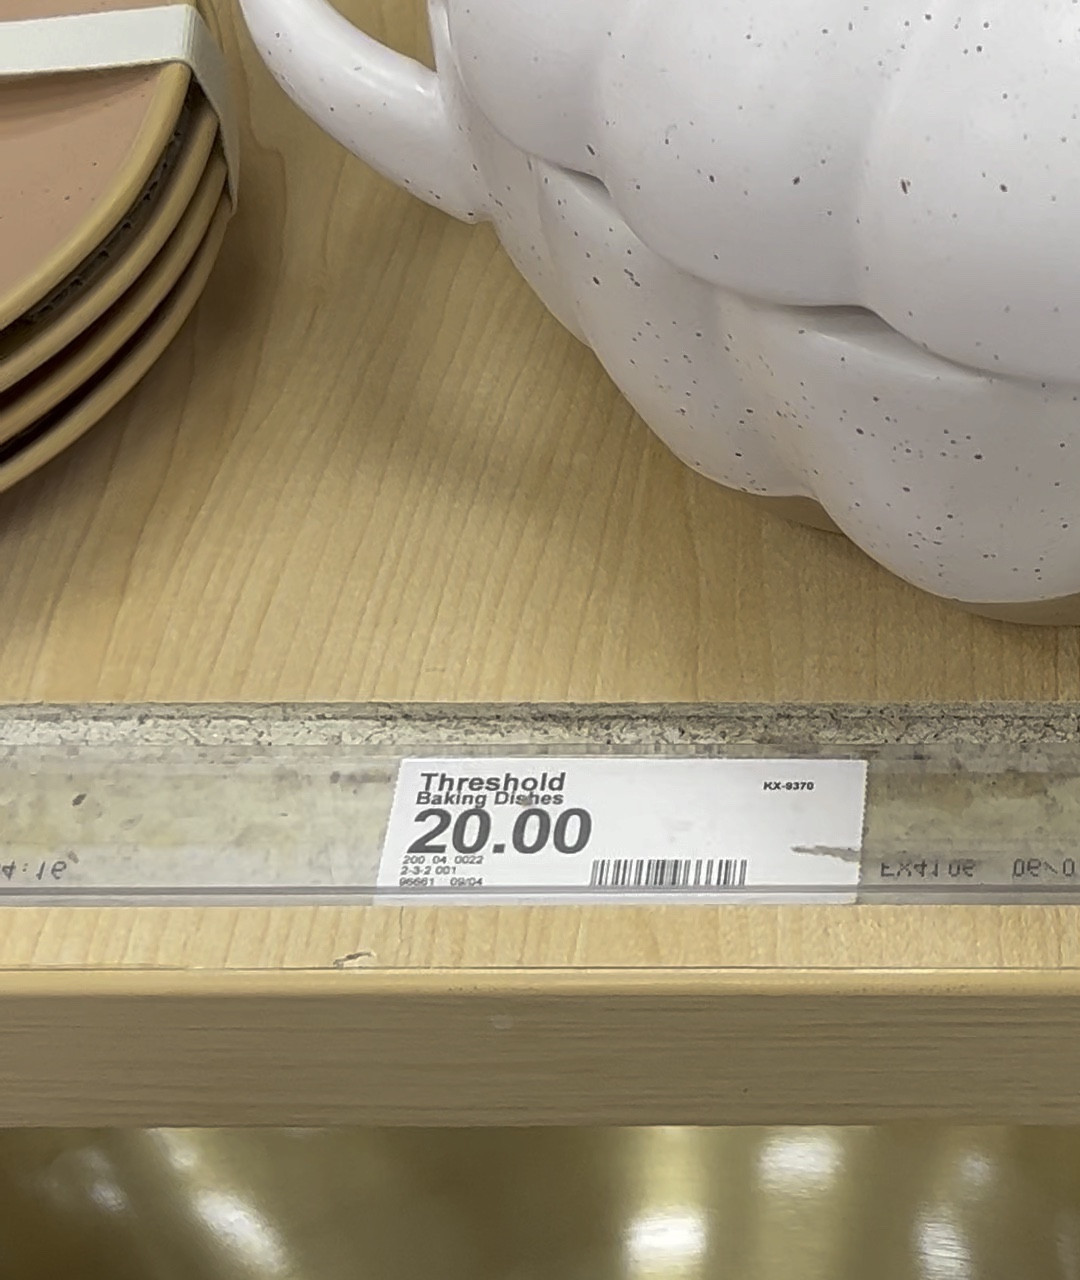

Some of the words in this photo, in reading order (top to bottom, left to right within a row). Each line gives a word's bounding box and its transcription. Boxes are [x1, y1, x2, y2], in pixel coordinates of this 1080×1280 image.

[420, 771, 567, 792] Threshold
[416, 791, 487, 809] Baking
[494, 790, 565, 806] Dishes
[406, 807, 593, 855] 20.00
